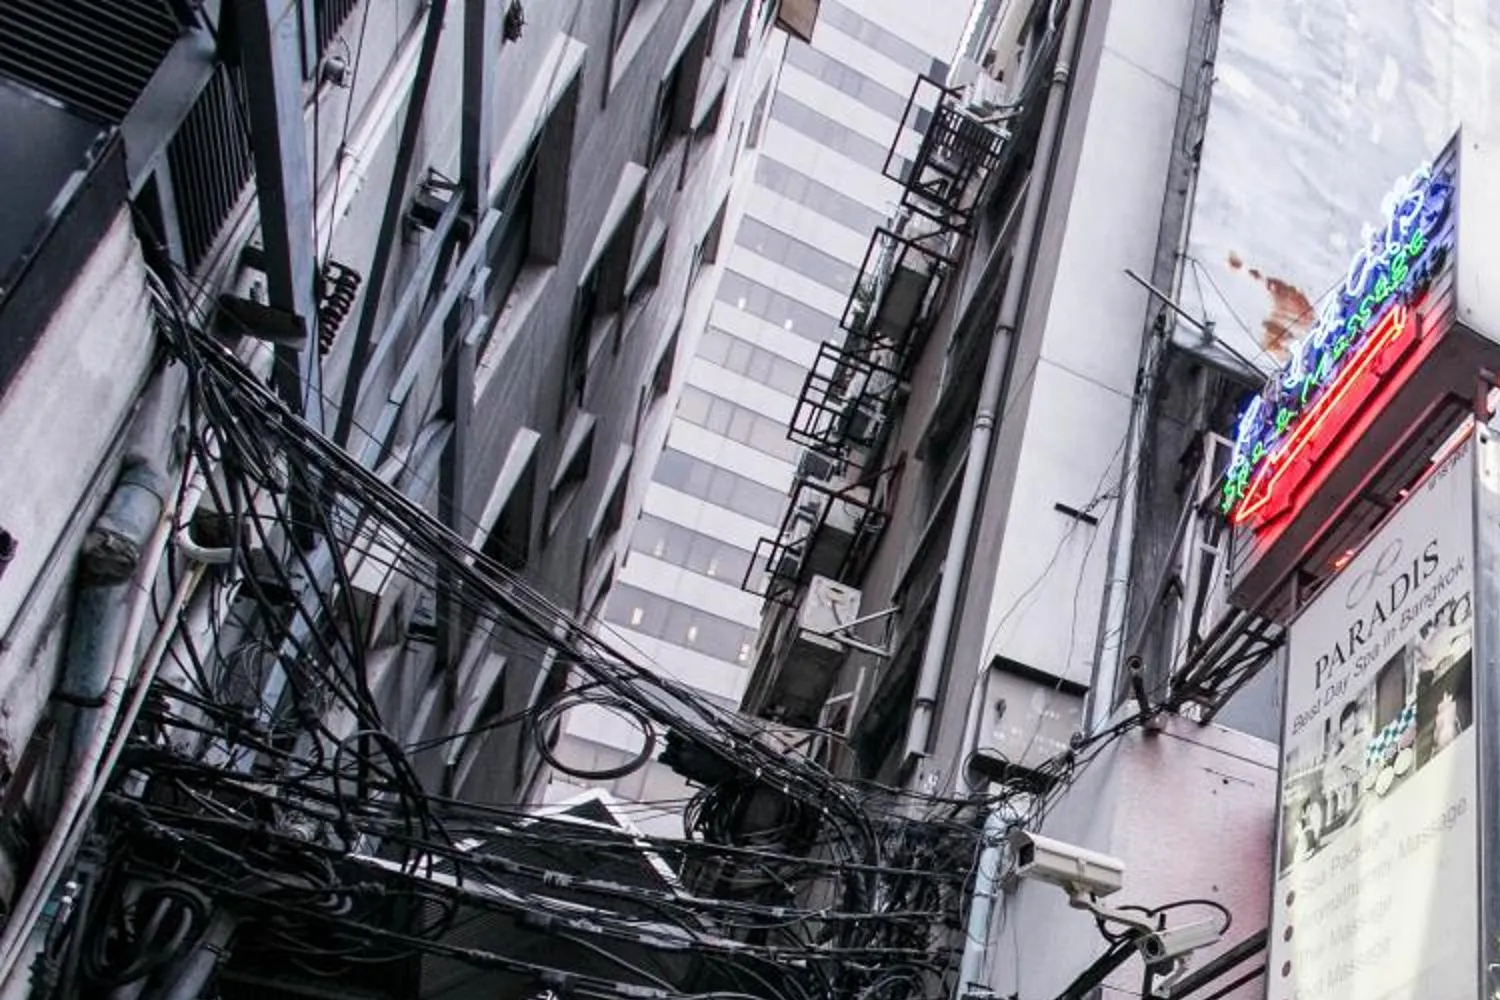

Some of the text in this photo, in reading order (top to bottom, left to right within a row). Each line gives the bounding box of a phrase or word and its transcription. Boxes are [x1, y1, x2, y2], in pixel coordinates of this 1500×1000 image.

[1313, 539, 1440, 690] PARADIS
[1323, 679, 1348, 713] Day
[1353, 646, 1382, 679] Spa
[1383, 624, 1399, 651] in
[1400, 555, 1465, 630] Bangkok
